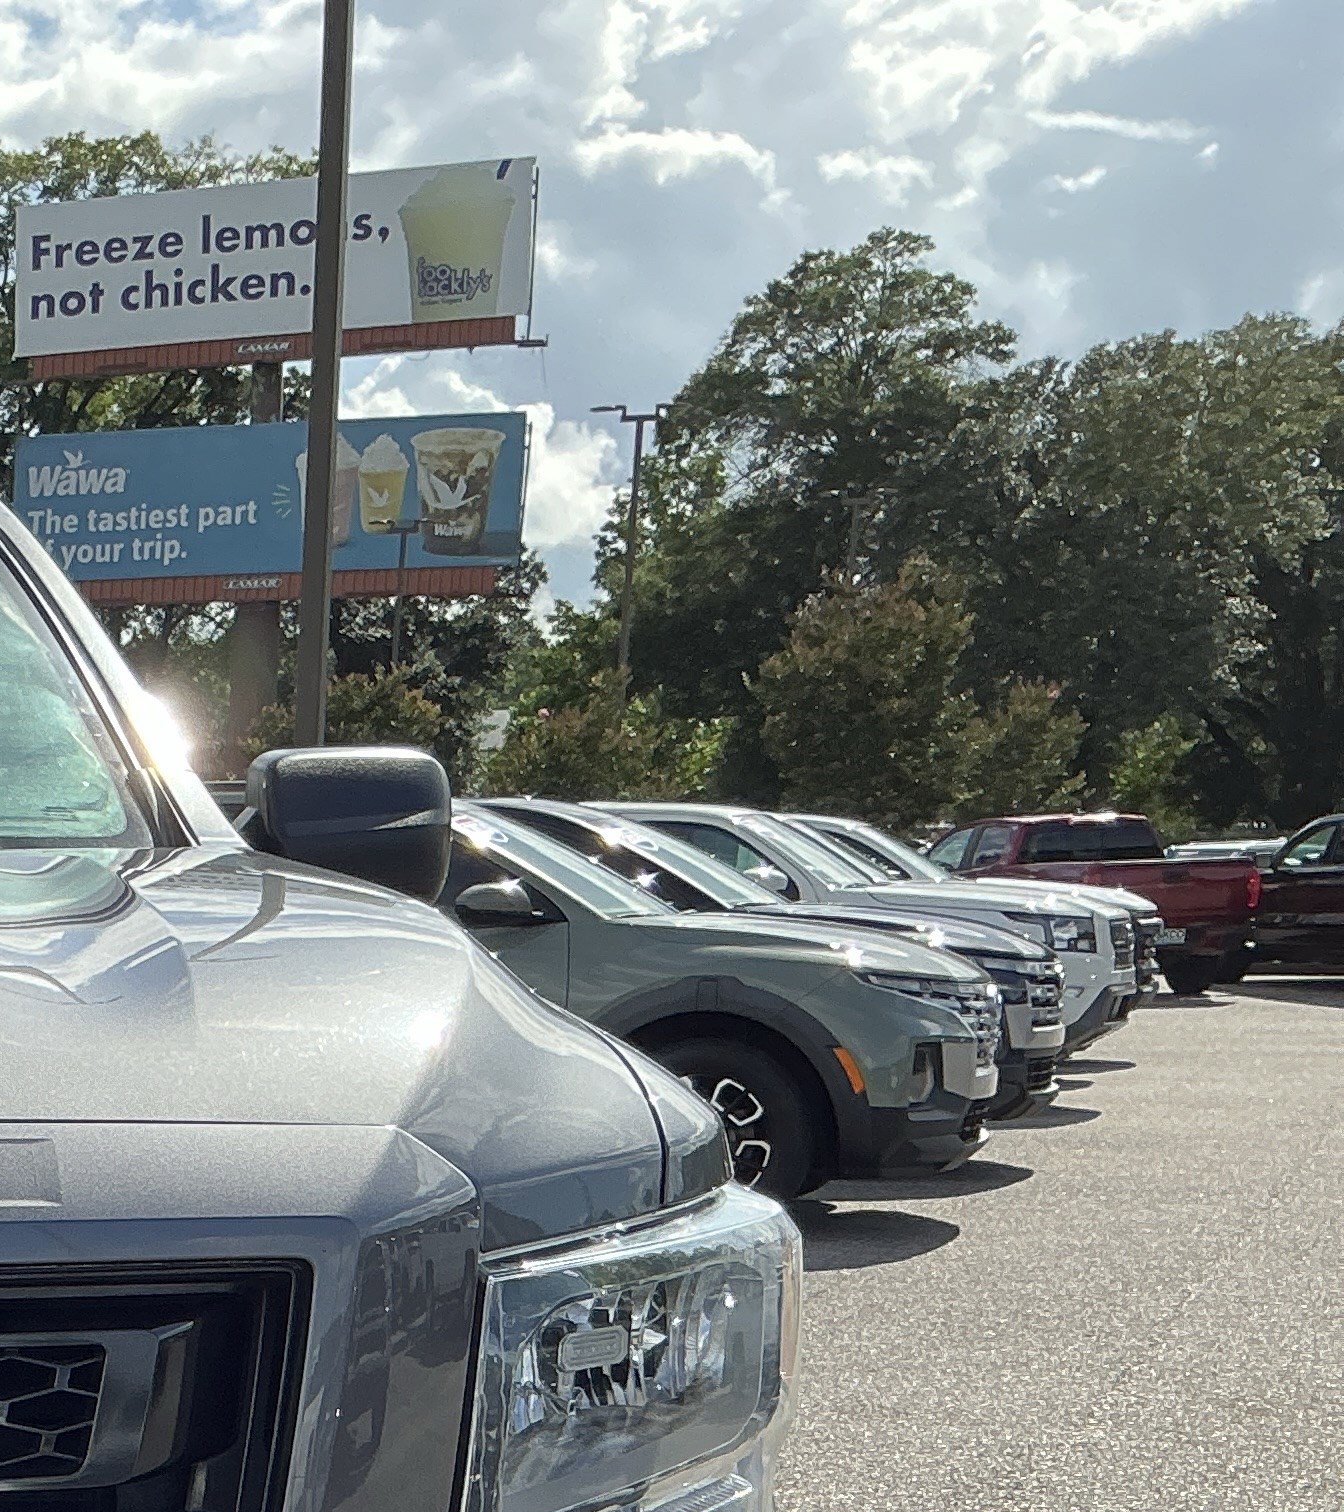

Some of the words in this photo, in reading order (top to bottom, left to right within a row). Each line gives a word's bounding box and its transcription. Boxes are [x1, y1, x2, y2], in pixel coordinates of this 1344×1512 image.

[30, 225, 184, 272] Freeze
[200, 212, 390, 255] lemos,
[29, 280, 105, 321] not
[119, 263, 312, 312] chicken.
[27, 464, 128, 498] Wawa
[27, 507, 79, 534] The
[87, 502, 189, 533] tastiest
[197, 500, 258, 534] part
[62, 541, 125, 571] your
[131, 532, 189, 567] trip.
